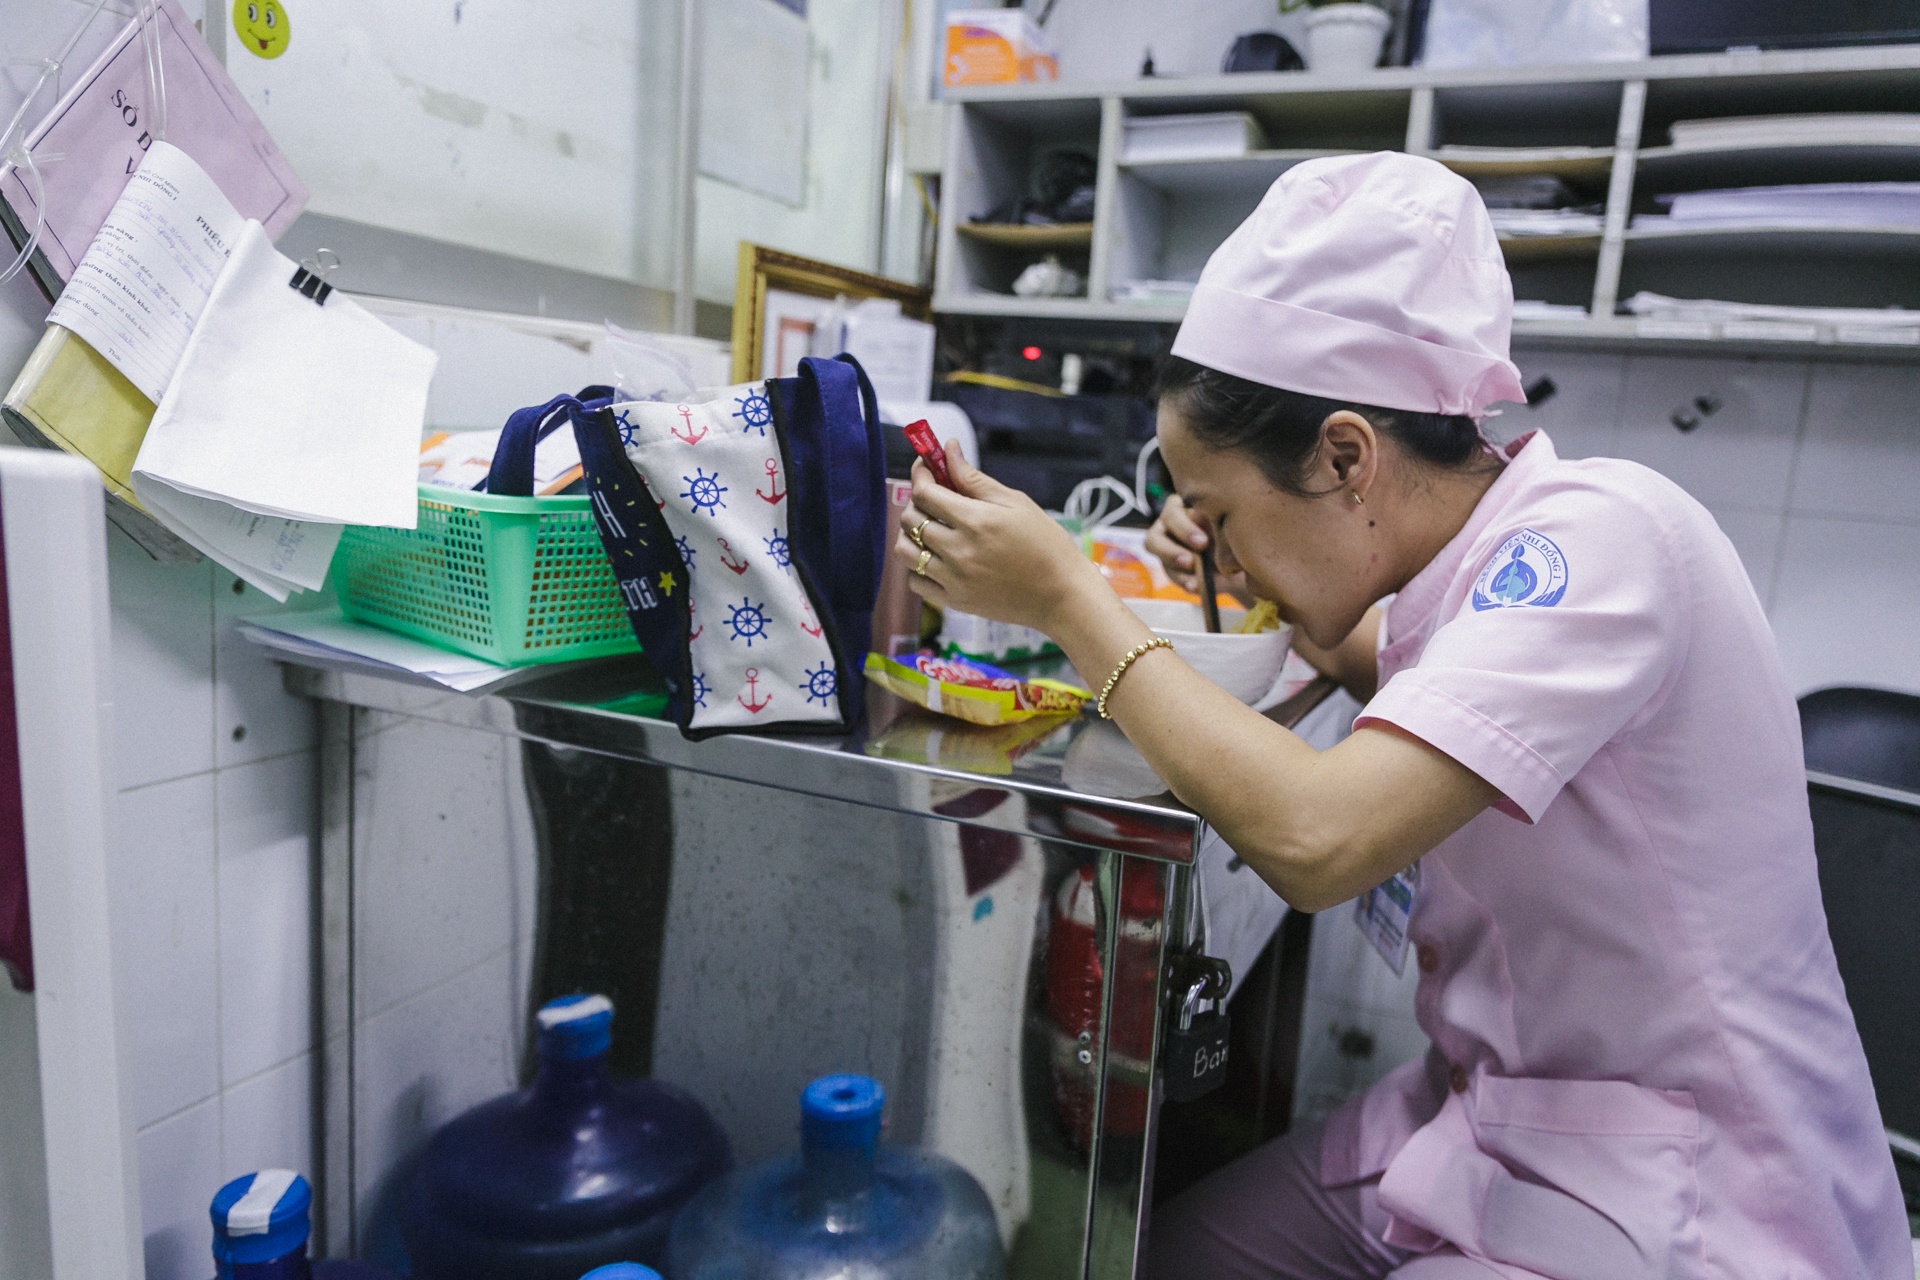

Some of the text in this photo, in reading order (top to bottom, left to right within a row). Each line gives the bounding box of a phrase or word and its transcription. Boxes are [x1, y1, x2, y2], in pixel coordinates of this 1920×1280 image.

[125, 156, 136, 175] V
[196, 215, 225, 249] PHIẾU
[122, 285, 137, 300] kinh
[1521, 532, 1541, 546] NHI
